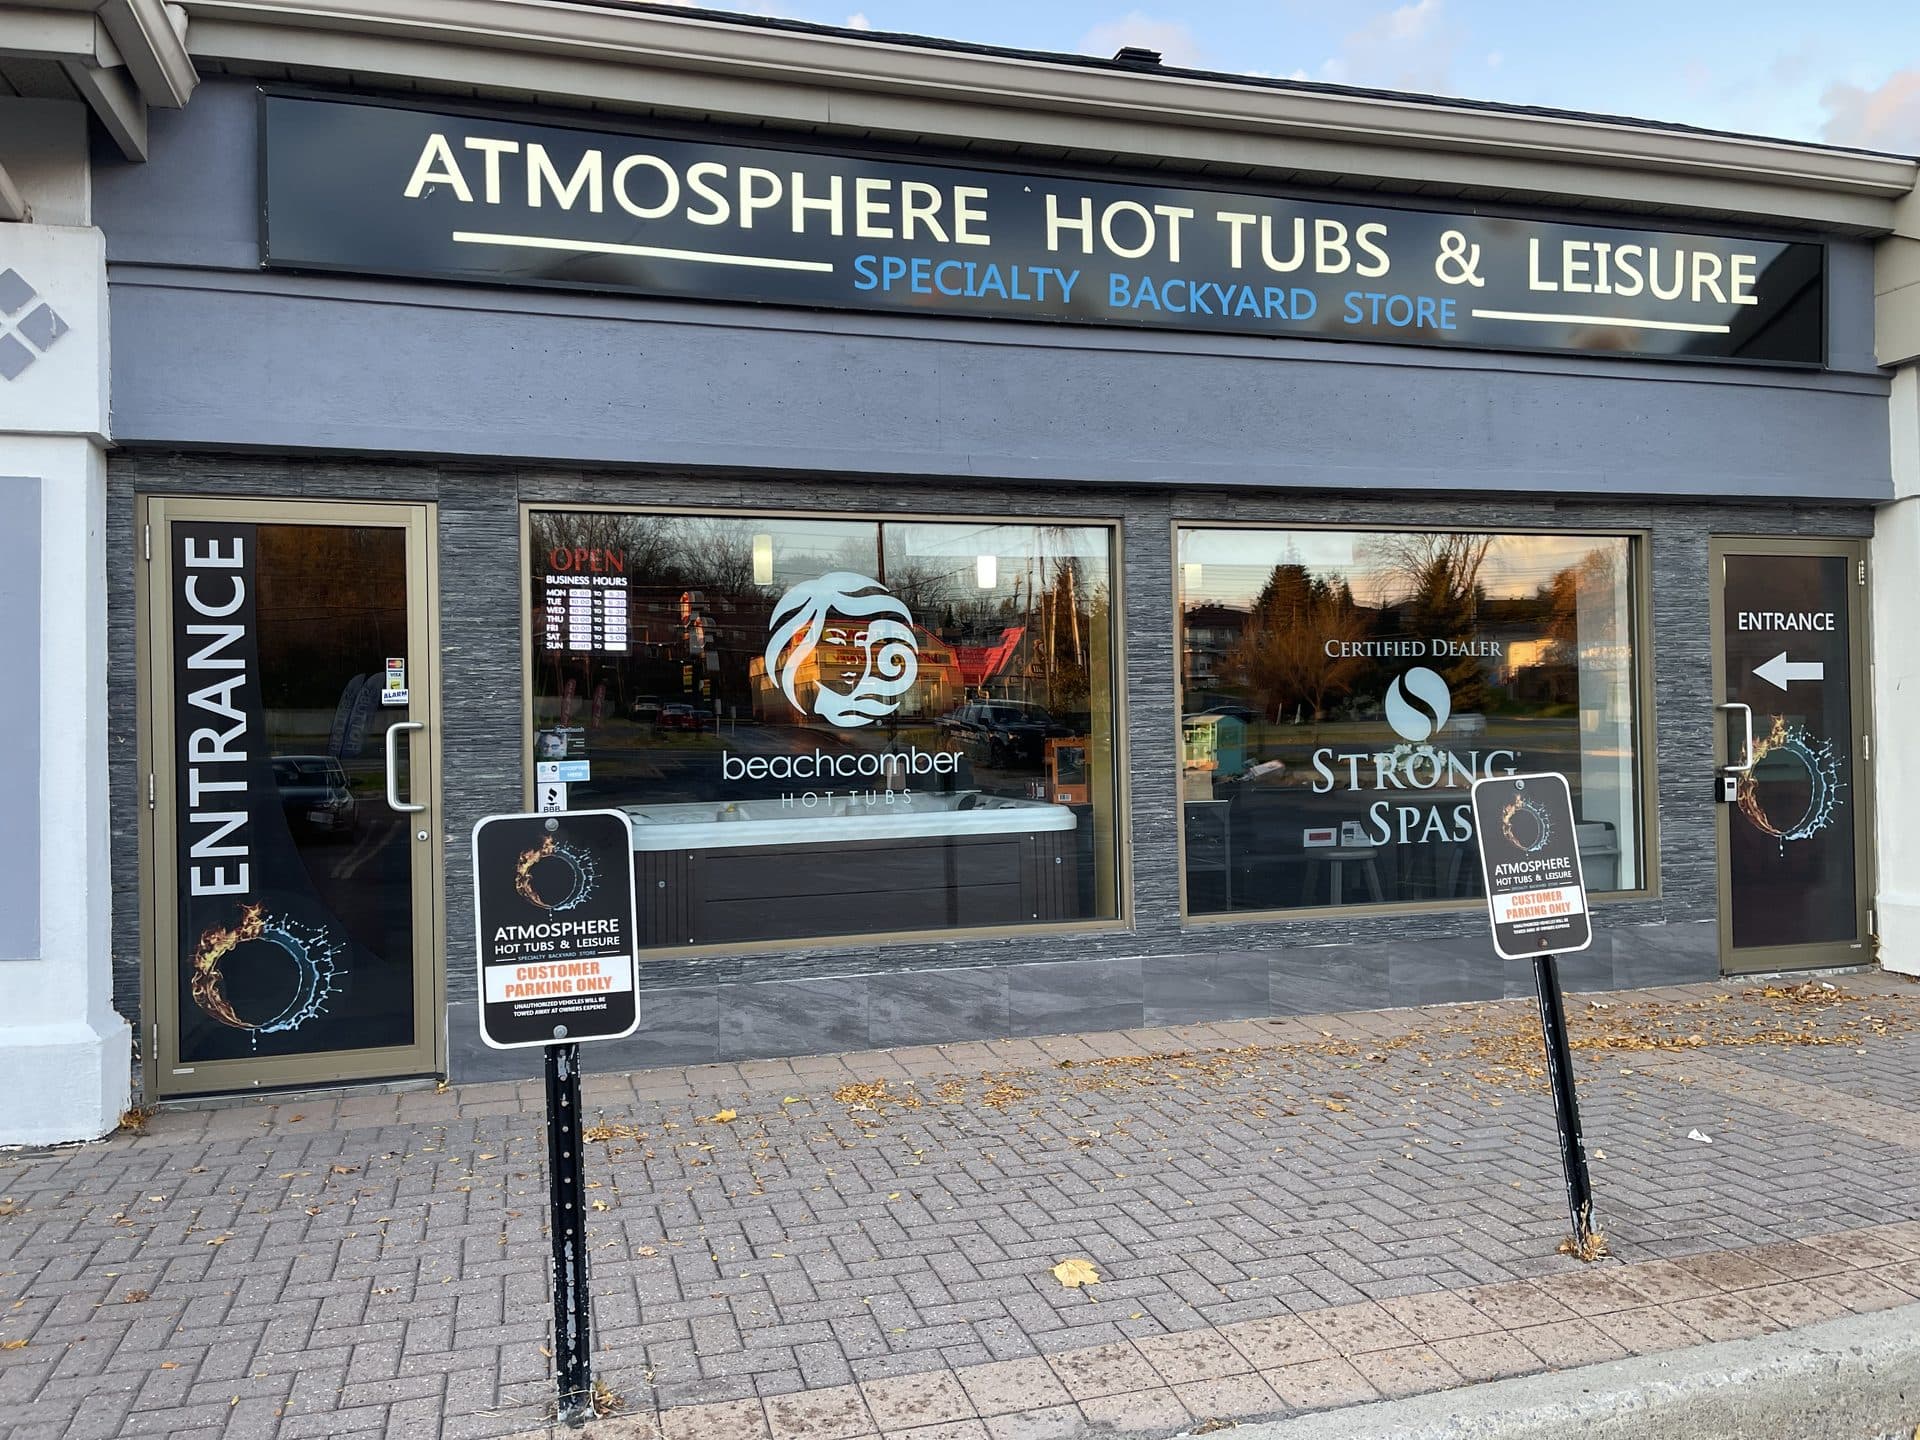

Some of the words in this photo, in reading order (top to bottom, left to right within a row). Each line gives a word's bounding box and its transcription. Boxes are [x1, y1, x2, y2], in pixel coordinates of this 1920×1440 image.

[403, 133, 991, 247] ATMOSPHERE
[1045, 193, 1195, 263] HOT
[1216, 211, 1391, 278] TUBS
[1434, 229, 1485, 288] &
[1528, 238, 1760, 306] LEISURE
[853, 254, 1081, 304] SPECIALTY
[1108, 272, 1317, 321] BACKYARD
[1343, 290, 1457, 331] STORE
[548, 546, 625, 572] OPEN
[546, 575, 590, 585] BUSINESS
[592, 577, 628, 586] HOURS
[546, 589, 567, 597] MON
[546, 615, 564, 623] THU
[546, 624, 559, 632] FRI
[1738, 612, 1835, 631] ENTRANCE
[546, 641, 564, 650] SUN
[1324, 639, 1426, 658] CERTIFIED
[1431, 638, 1504, 657] DEALER
[383, 690, 408, 699] ALARM
[184, 537, 250, 896] ENTRANCE
[722, 745, 964, 781] beachcomber
[1311, 748, 1518, 794] STRONG
[781, 791, 834, 809] HOT
[849, 788, 912, 806] TUBS
[1369, 801, 1473, 846] SPAS
[1494, 857, 1571, 876] ATMOSPHERE
[1496, 877, 1512, 886] HOT
[1513, 875, 1533, 884] TUBS
[1535, 873, 1542, 881] &
[1545, 870, 1573, 880] LEISURE
[1511, 890, 1563, 906] CUSTOMER
[1505, 904, 1547, 920] PARKING
[1548, 902, 1571, 914] ONLY
[494, 918, 620, 942] ATMOSPHERE
[494, 943, 521, 955] HOT
[523, 941, 555, 952] TUBS
[560, 940, 571, 949] &
[576, 936, 621, 948] LEISURE
[516, 961, 601, 981] CUSTOMER
[505, 979, 573, 998] PARKING
[576, 976, 612, 992] ONLY
[513, 1008, 534, 1017] TOWED
[583, 1003, 607, 1011] EXPENSE
[514, 1000, 558, 1010] UNAUTHORIZED
[558, 998, 584, 1006] VEHICLES
